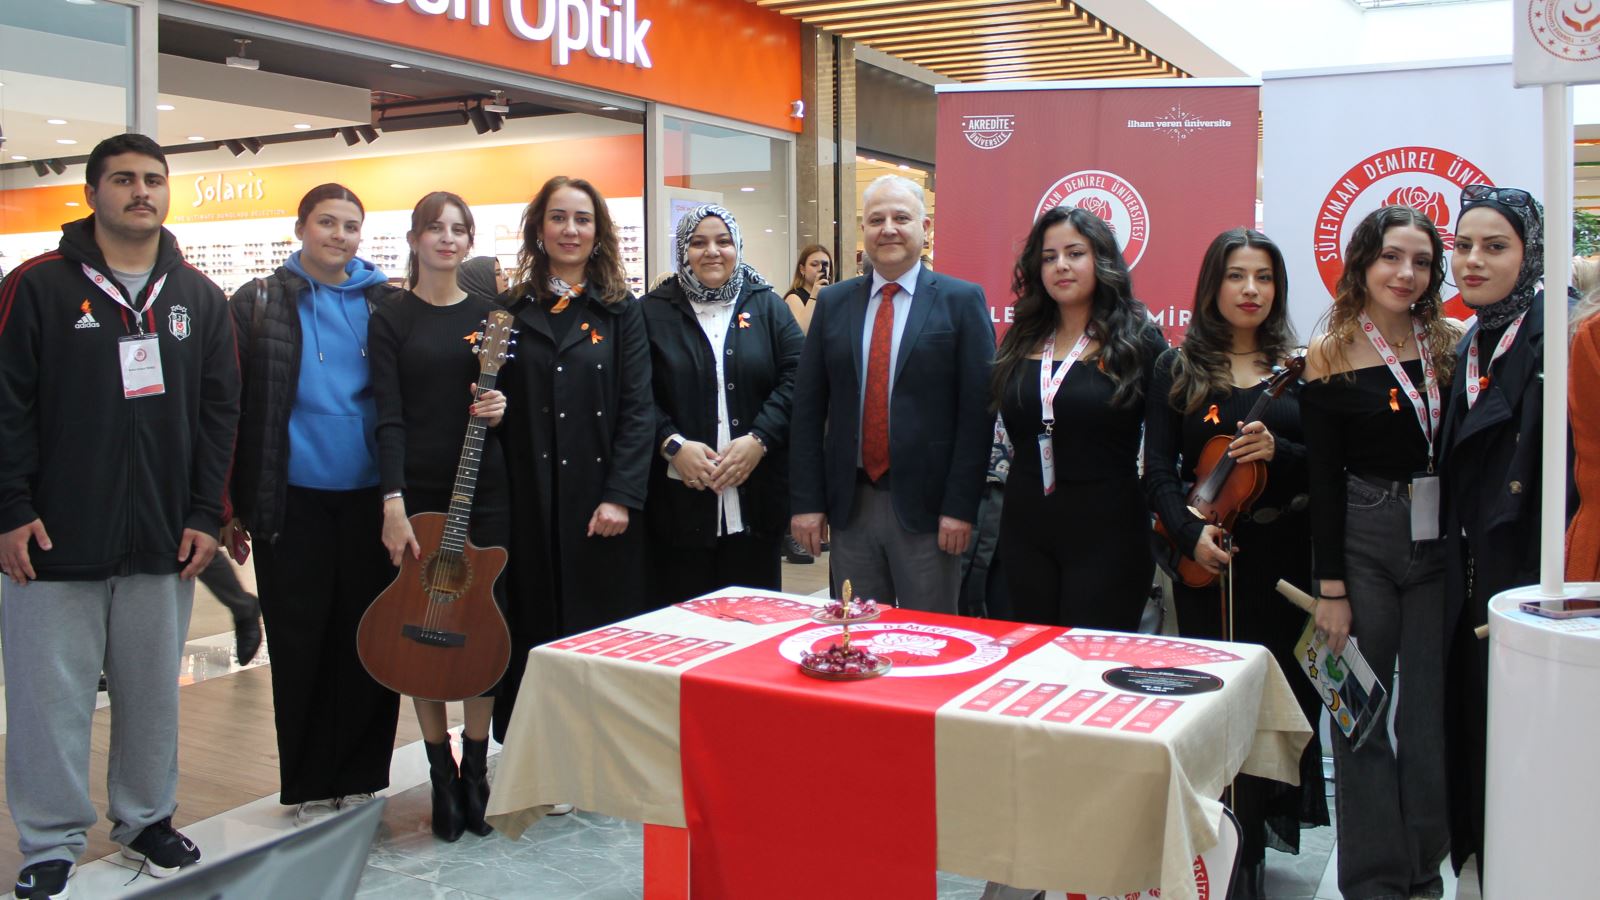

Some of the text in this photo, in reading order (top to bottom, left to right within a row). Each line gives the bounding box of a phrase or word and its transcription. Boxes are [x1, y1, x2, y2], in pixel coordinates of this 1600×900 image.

[968, 116, 1010, 130] AKREDİTE
[1127, 119, 1232, 128] ilham veren üniversite
[970, 131, 1008, 147] ÜNİVERSİTE
[192, 171, 264, 207] Solaris
[1064, 174, 1105, 193] DEMİREL
[1110, 179, 1145, 241] ÜNİVERSİTESİ
[1314, 178, 1360, 262] SÜLEYMAN
[1363, 149, 1435, 180] DEMİREL
[74, 321, 100, 329] adidas
